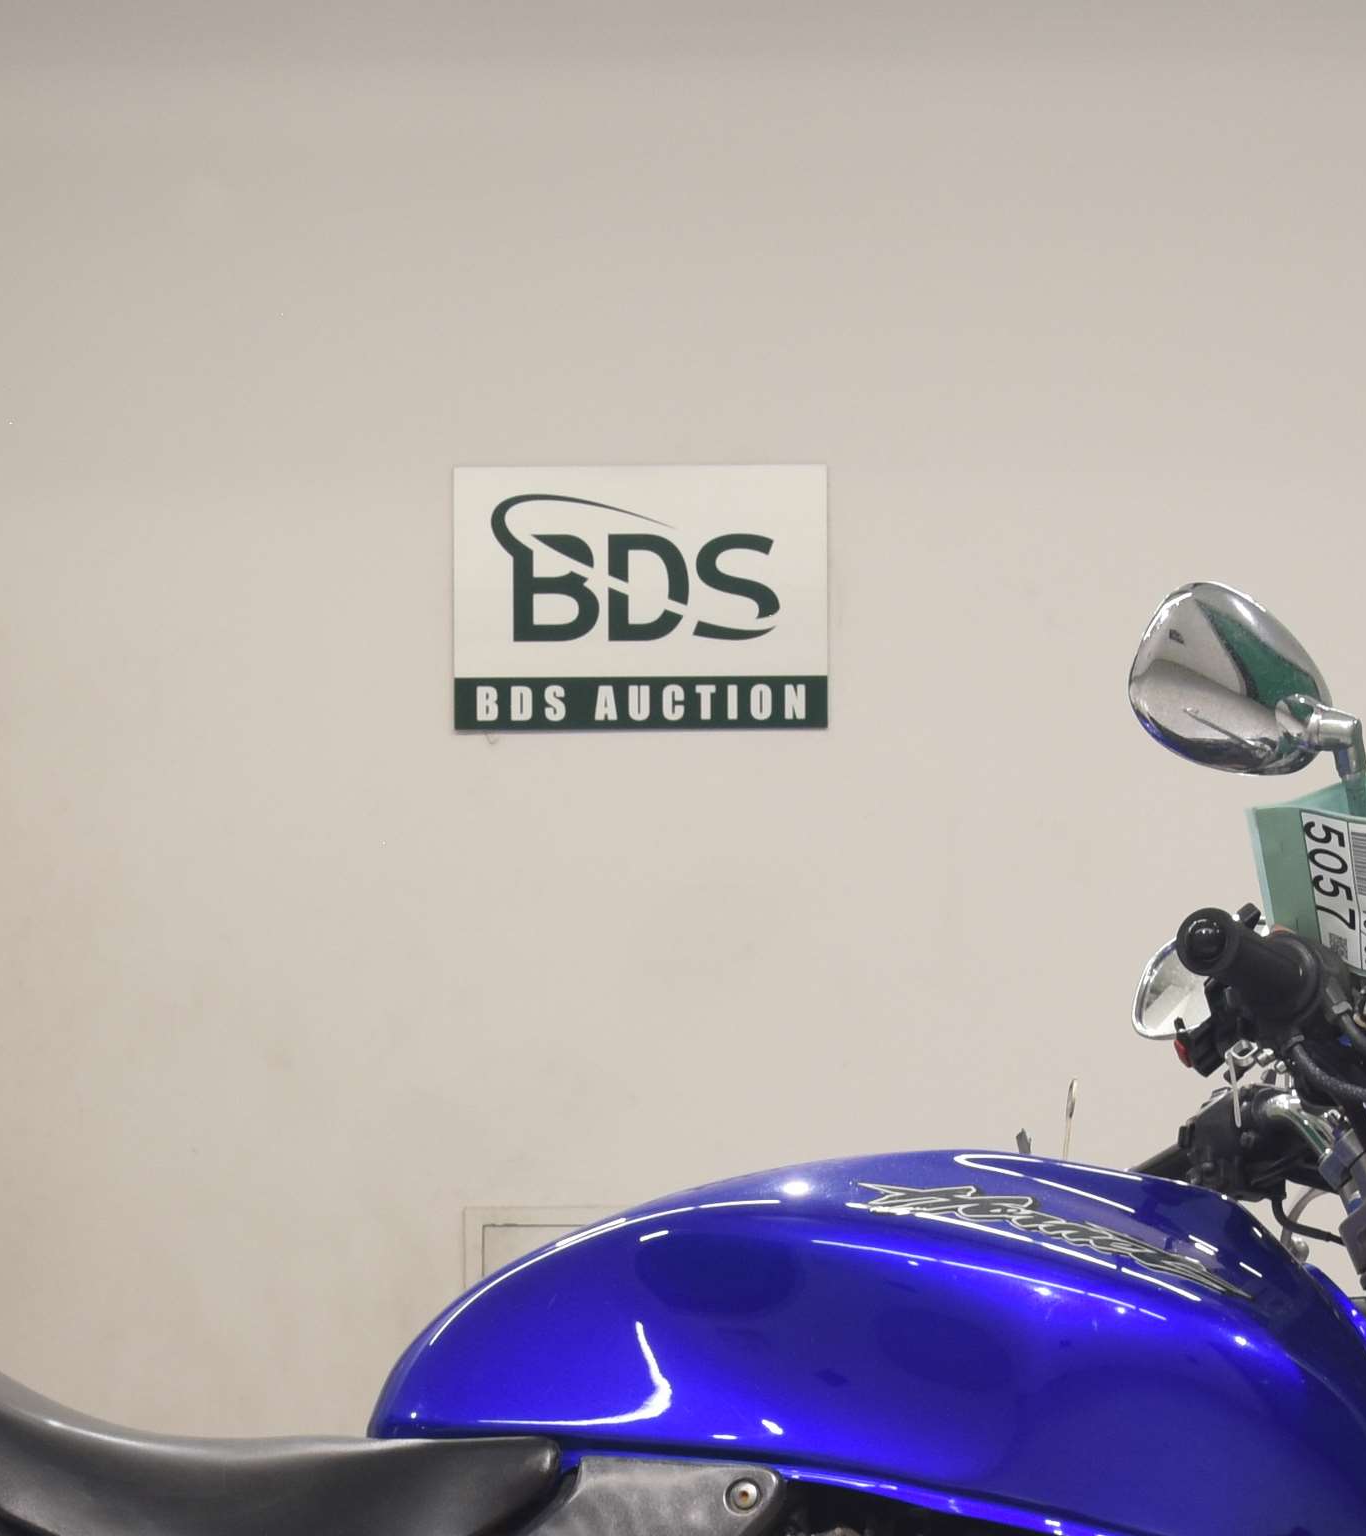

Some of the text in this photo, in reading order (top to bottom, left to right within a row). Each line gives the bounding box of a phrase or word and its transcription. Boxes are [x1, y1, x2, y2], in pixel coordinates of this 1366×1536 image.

[491, 493, 781, 642] BDS
[475, 683, 807, 722] BDS AUCTION
[1303, 820, 1356, 931] 5057
